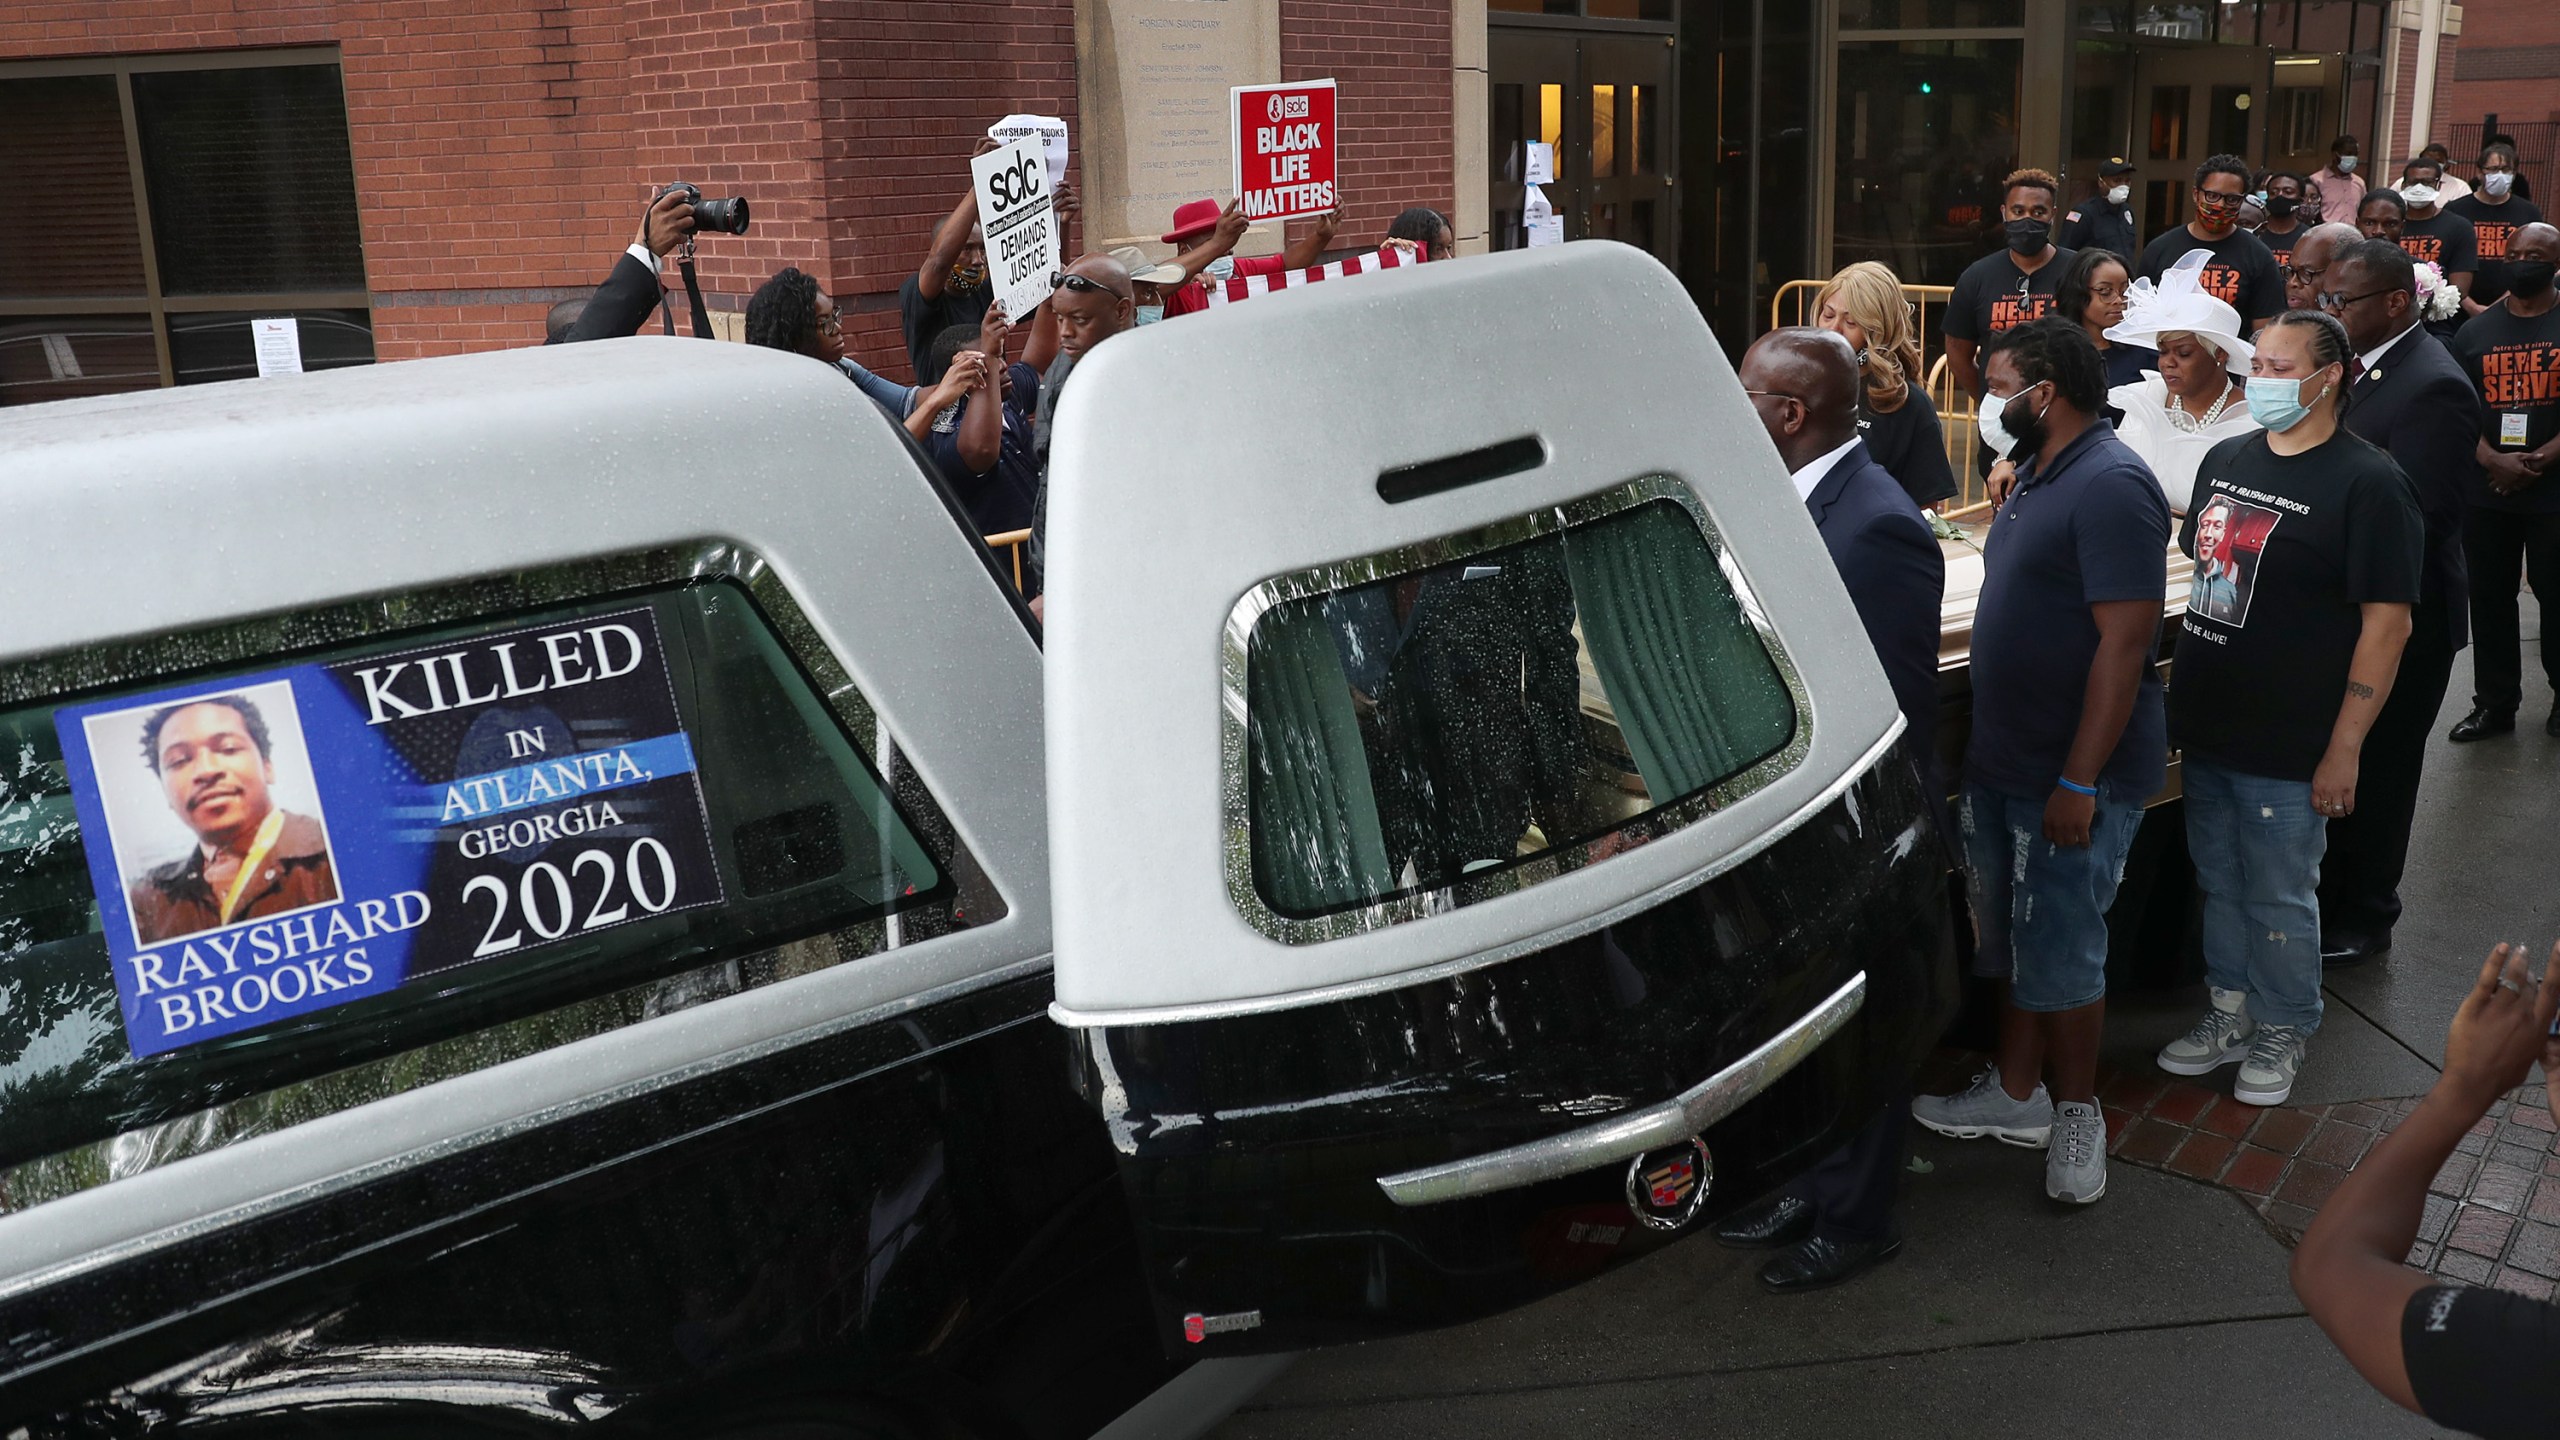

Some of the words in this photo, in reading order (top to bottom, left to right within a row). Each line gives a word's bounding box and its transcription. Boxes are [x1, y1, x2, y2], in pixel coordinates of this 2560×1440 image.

[1176, 20, 1221, 29] SANCTUARY
[993, 127, 1034, 137] RAYSHARD
[1036, 128, 1065, 137] ROOKS
[1257, 122, 1322, 154] BLACK
[989, 149, 1039, 212] sclc
[1270, 153, 1311, 183] LIFE
[1244, 180, 1334, 217] MATTERS
[1000, 217, 1047, 262] DEMANDS
[2400, 240, 2428, 254] ERE
[2431, 239, 2442, 253] 2
[2477, 239, 2508, 256] ERV
[1009, 243, 1049, 286] JUSTICE!
[2199, 270, 2222, 287] RE
[2226, 270, 2241, 288] 2
[2229, 484, 2238, 492] IS
[2275, 496, 2311, 515] BROOKS
[2193, 625, 2203, 636] BE
[2202, 629, 2228, 645] ALIVE!
[353, 623, 643, 727] KILLED
[505, 725, 548, 760] IN
[439, 753, 654, 823] ATLANTA,
[457, 801, 625, 860] GEORGIA
[461, 836, 679, 958] 2020
[128, 889, 432, 998] RAYSHARD
[159, 947, 375, 1037] BROOKS
